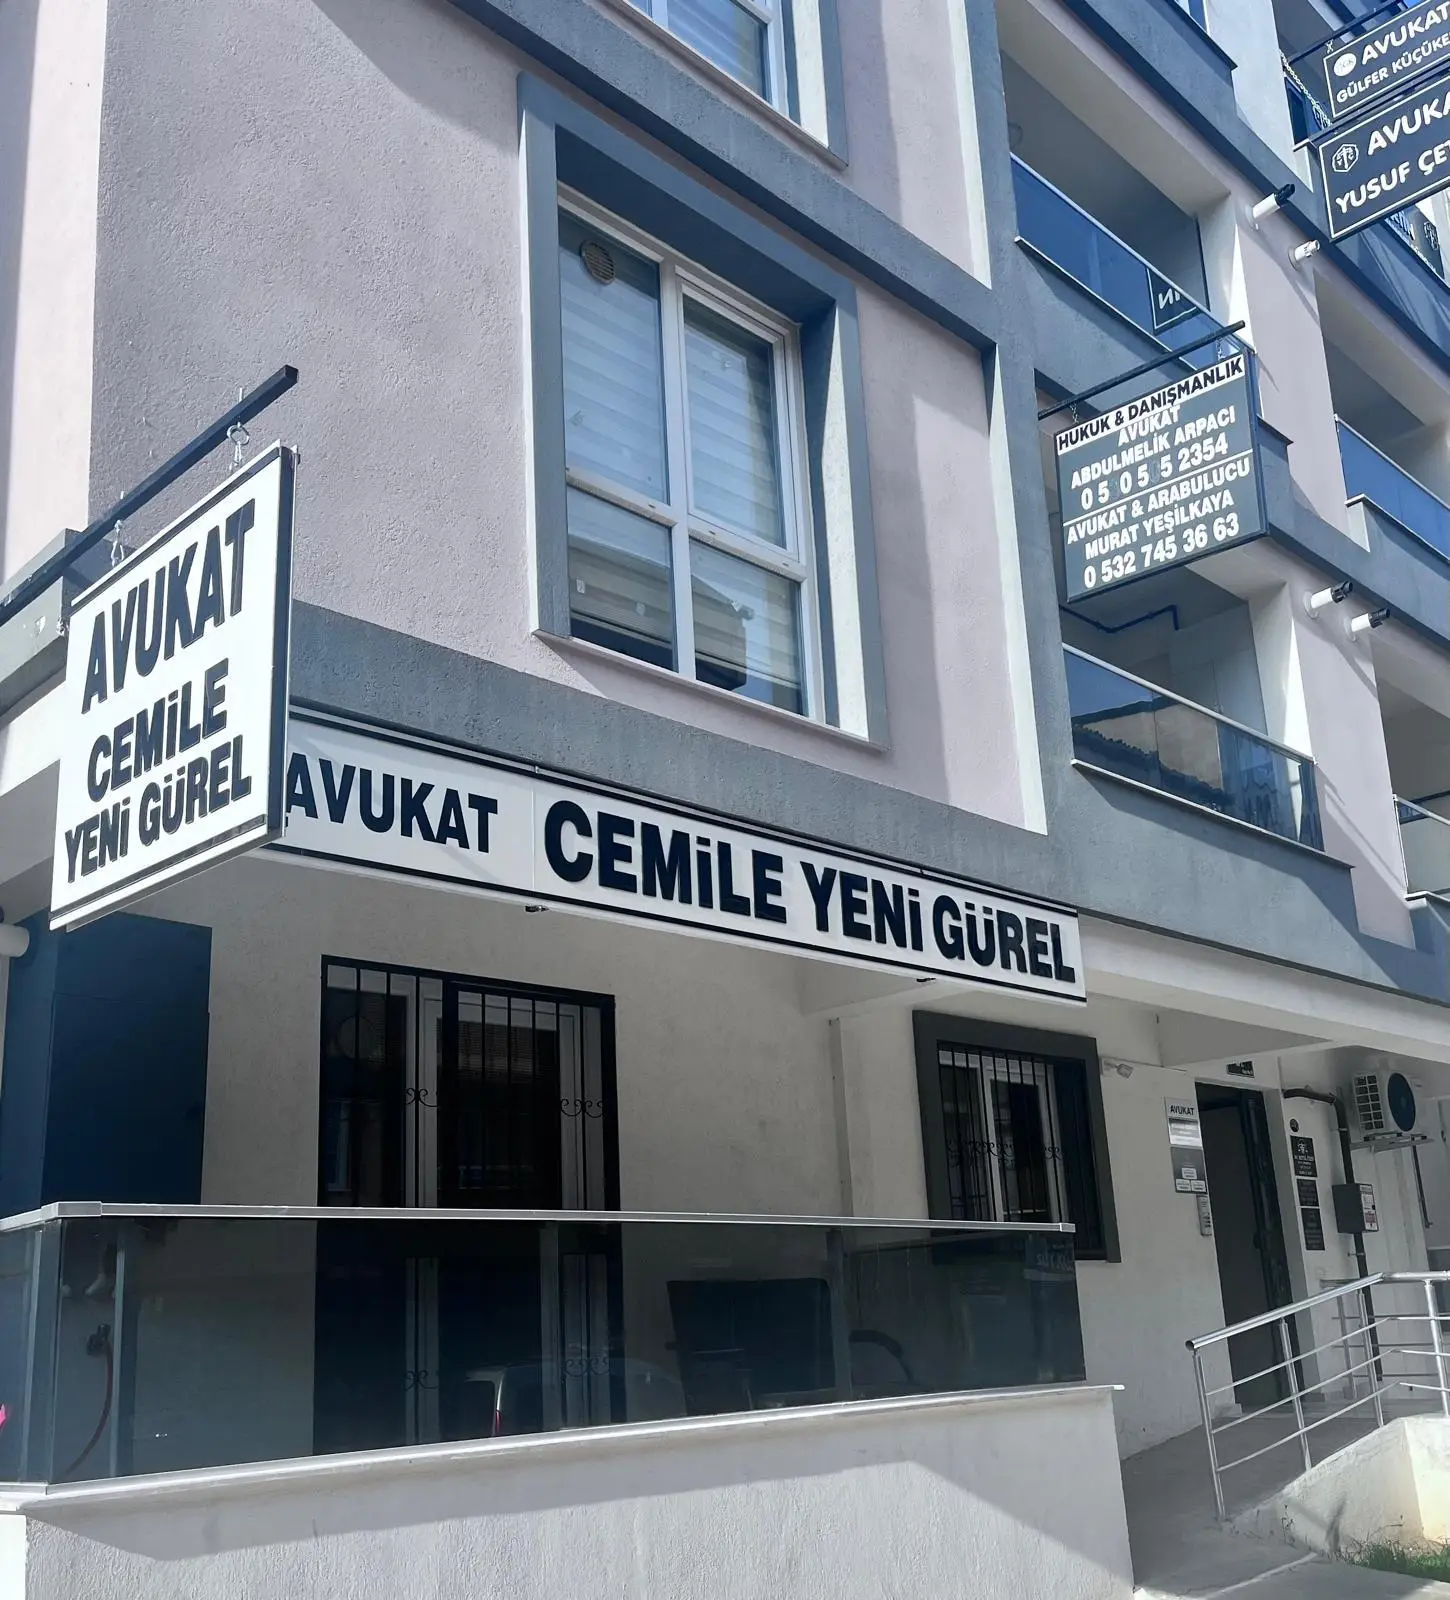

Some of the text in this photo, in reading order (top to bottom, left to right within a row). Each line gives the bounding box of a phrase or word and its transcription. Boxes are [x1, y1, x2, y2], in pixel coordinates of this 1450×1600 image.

[1361, 1, 1450, 65] AVUKAT
[1336, 66, 1389, 103] GÜLFER
[1335, 161, 1410, 214] YUSUF
[1059, 357, 1243, 450] HUKUK & DANIŞMANLIK
[1118, 404, 1181, 447] AVUKAT
[1071, 405, 1236, 489] ABDULMELİK ARPACI
[1177, 434, 1228, 472] 2354
[1067, 457, 1250, 545] AVUKAT & ARABULUCU
[1085, 489, 1235, 560] MURAT YEŞİLKAYA
[1084, 512, 1239, 588] 0 532 745 36 63
[81, 498, 255, 714] AVUKAT
[138, 734, 252, 847] GÜREL
[286, 752, 498, 853] AVUKAT
[932, 894, 1076, 983] GÜREL
[1170, 1105, 1195, 1116] AVUKAT
